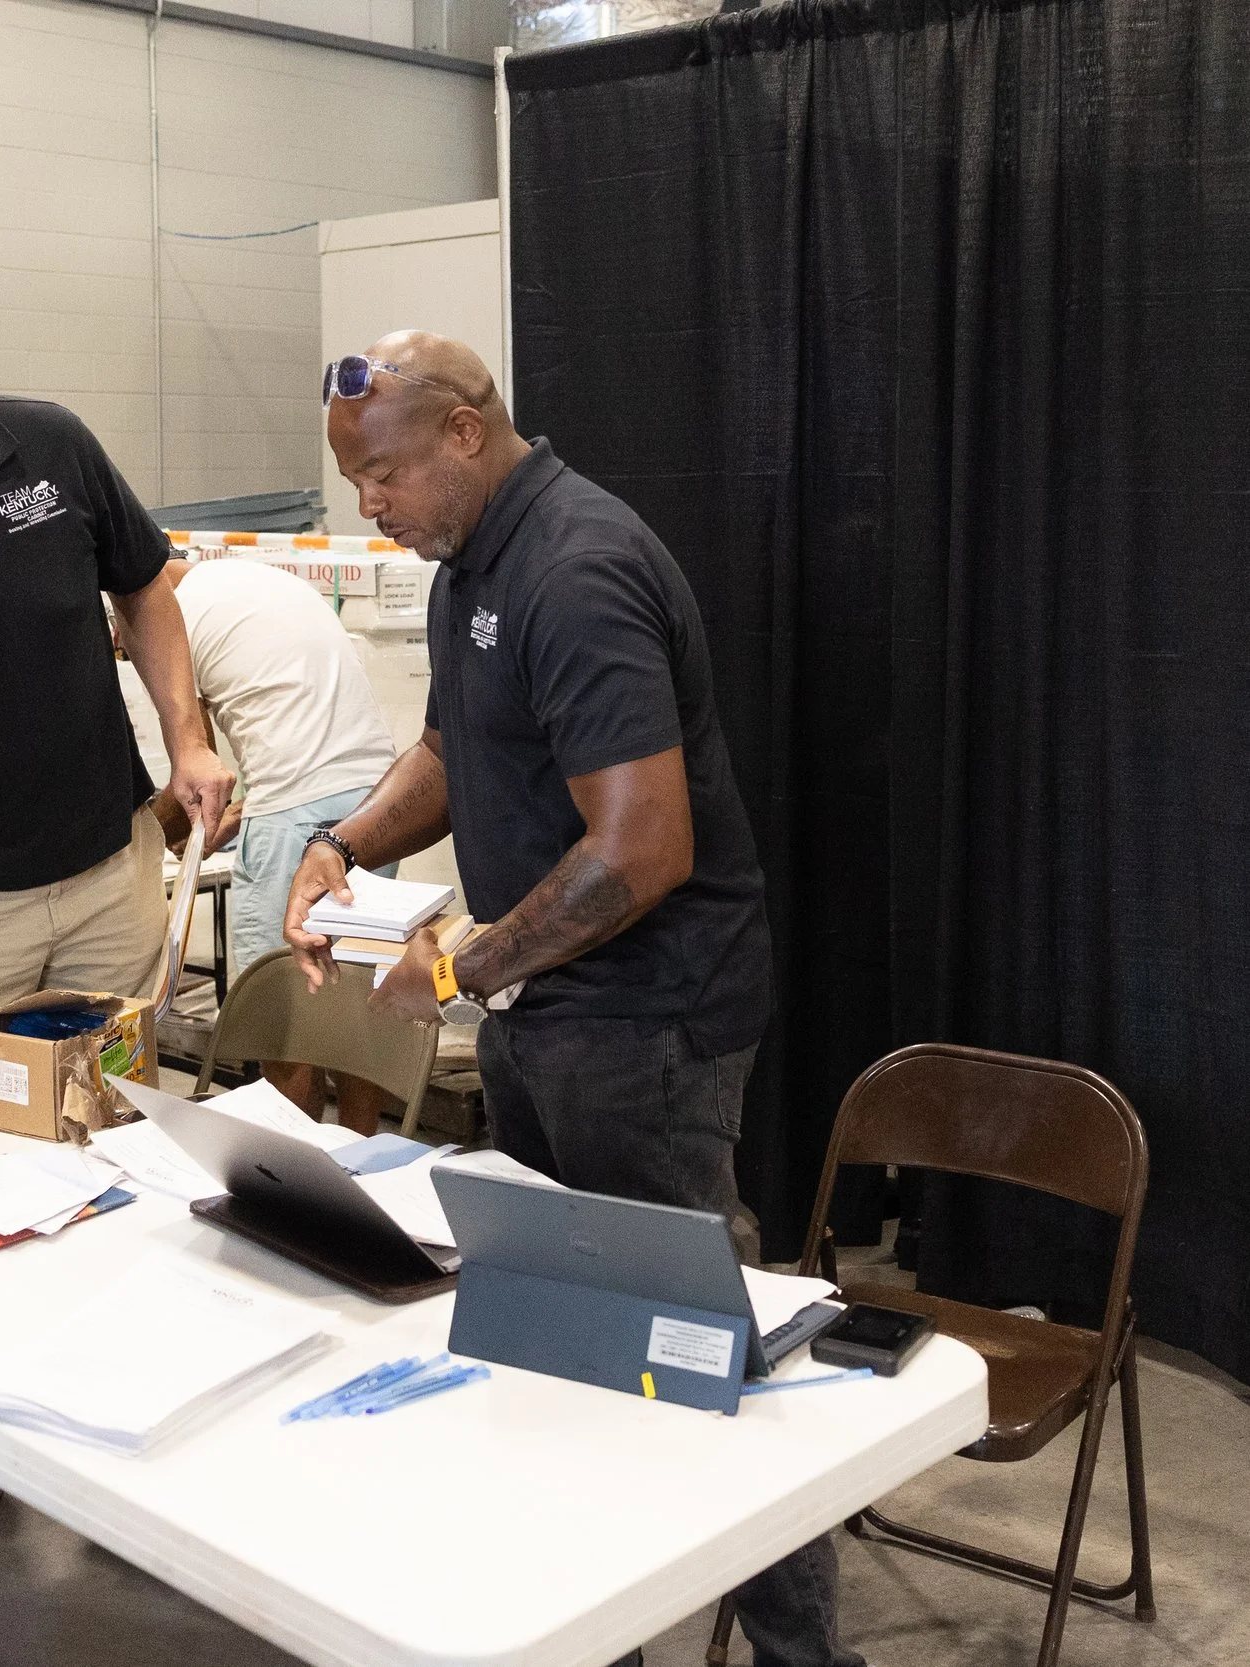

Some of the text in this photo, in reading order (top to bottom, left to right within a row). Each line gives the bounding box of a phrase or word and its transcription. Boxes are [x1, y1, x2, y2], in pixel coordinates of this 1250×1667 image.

[0, 485, 32, 503] TEAM
[0, 485, 58, 516] KENTUCKY
[11, 501, 57, 522] PUBLIC PROTECTION
